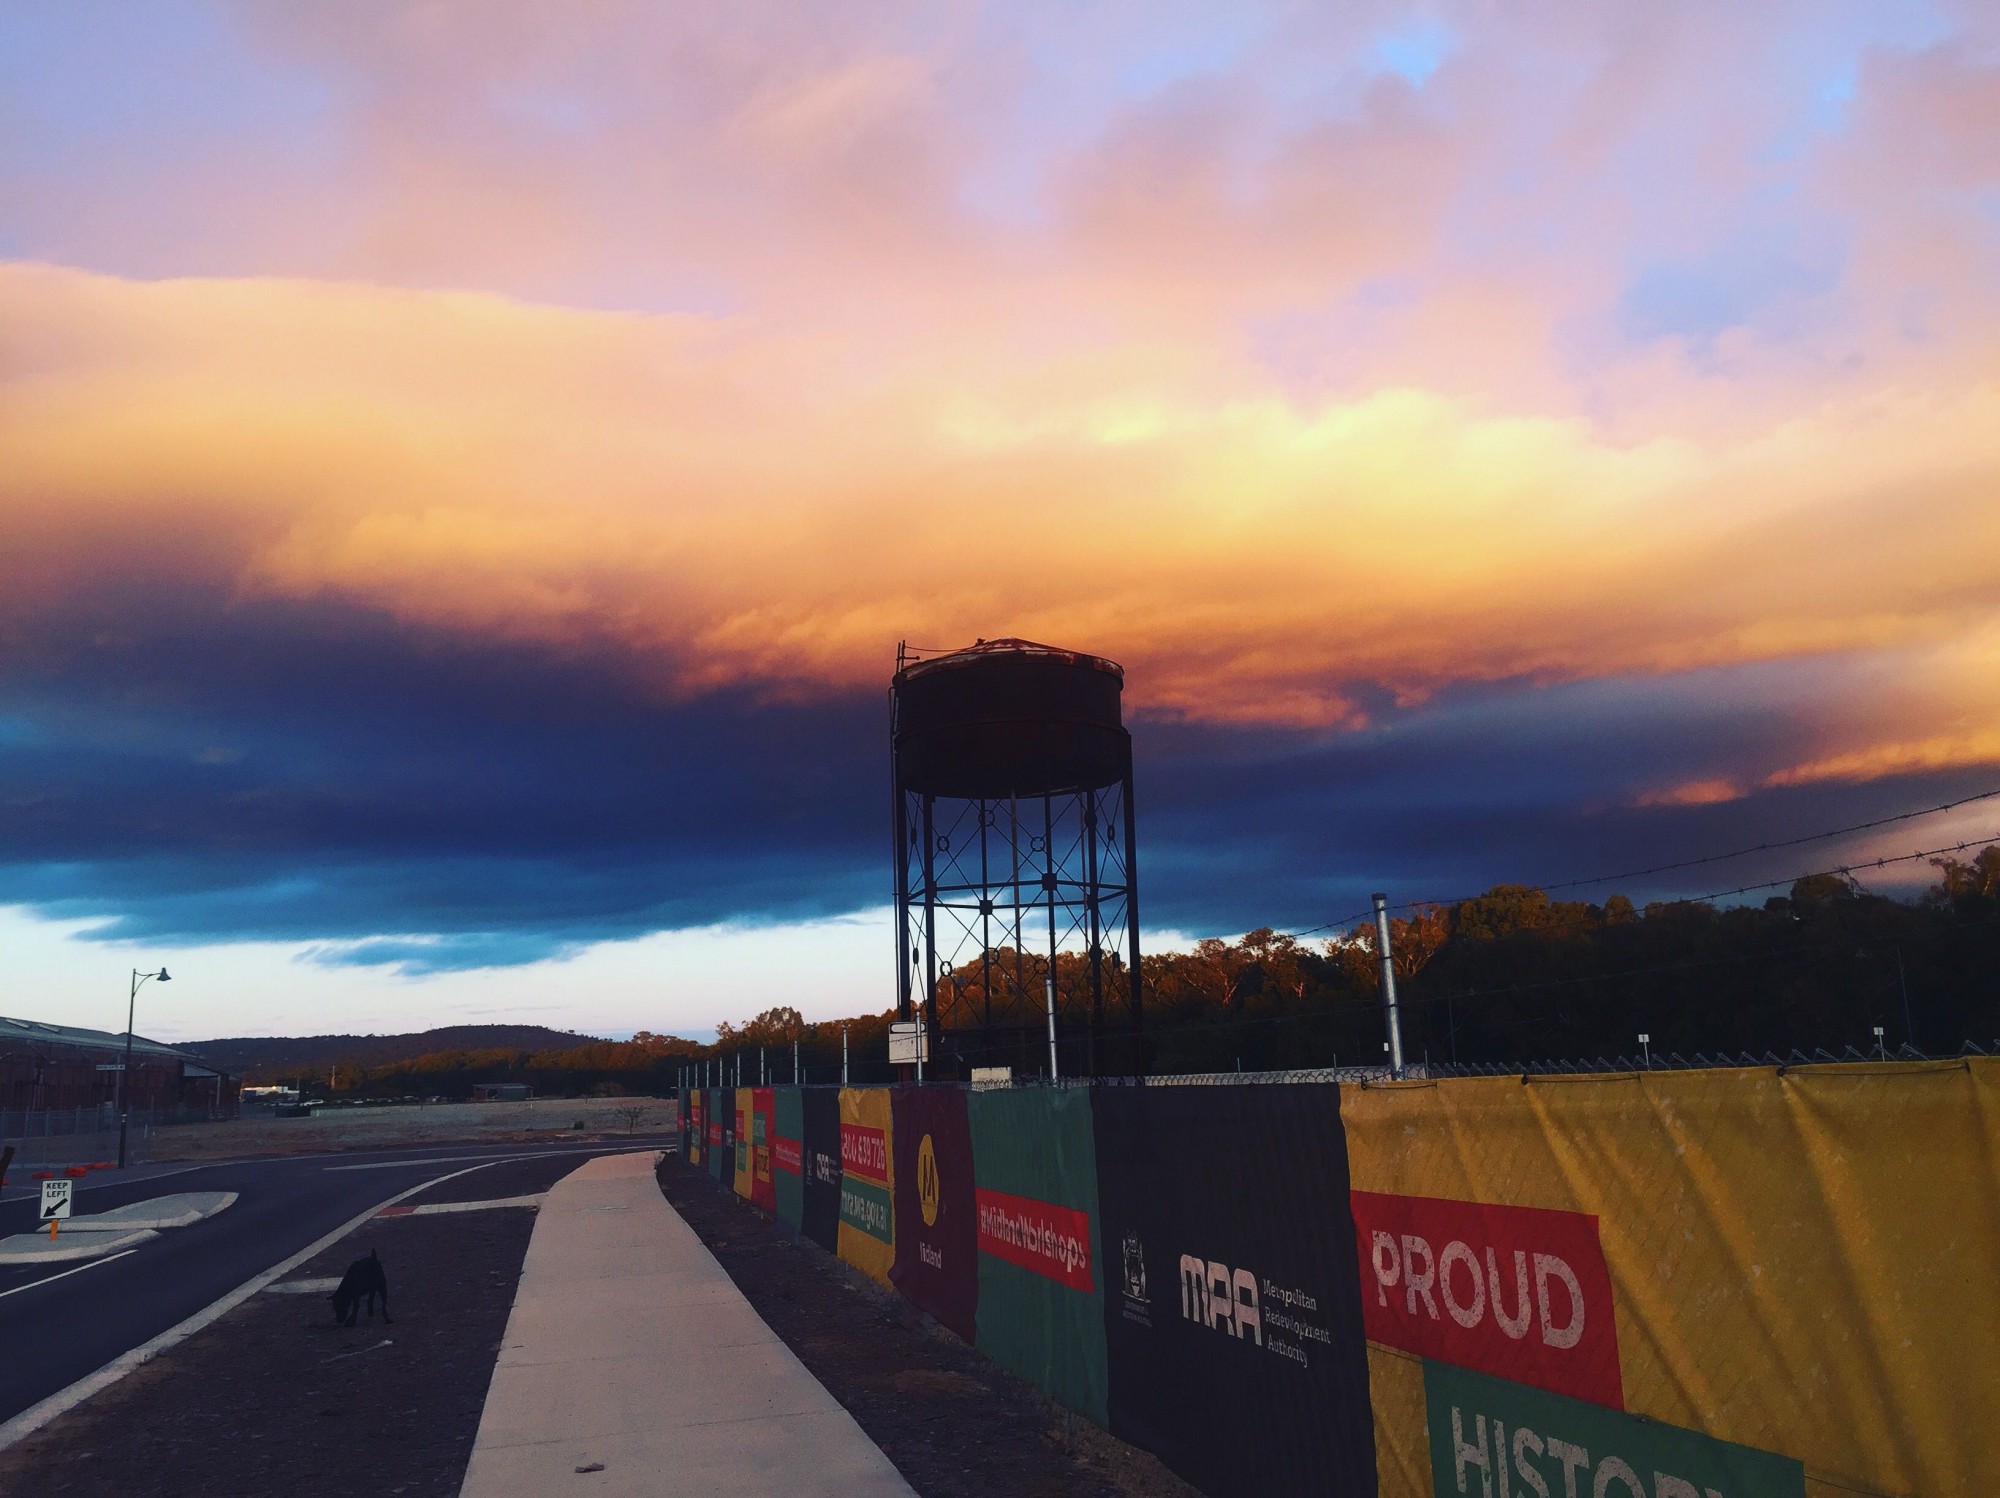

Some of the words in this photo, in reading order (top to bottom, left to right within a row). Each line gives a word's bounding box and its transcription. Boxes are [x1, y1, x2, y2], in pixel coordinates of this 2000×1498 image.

[46, 1182, 68, 1190] KEEP
[46, 1190, 67, 1198] LEFT
[1179, 1253, 1264, 1346] MRA
[1371, 1229, 1586, 1350] PROUD
[1267, 1333, 1308, 1369] Authority
[1451, 1405, 1724, 1498] HIST
